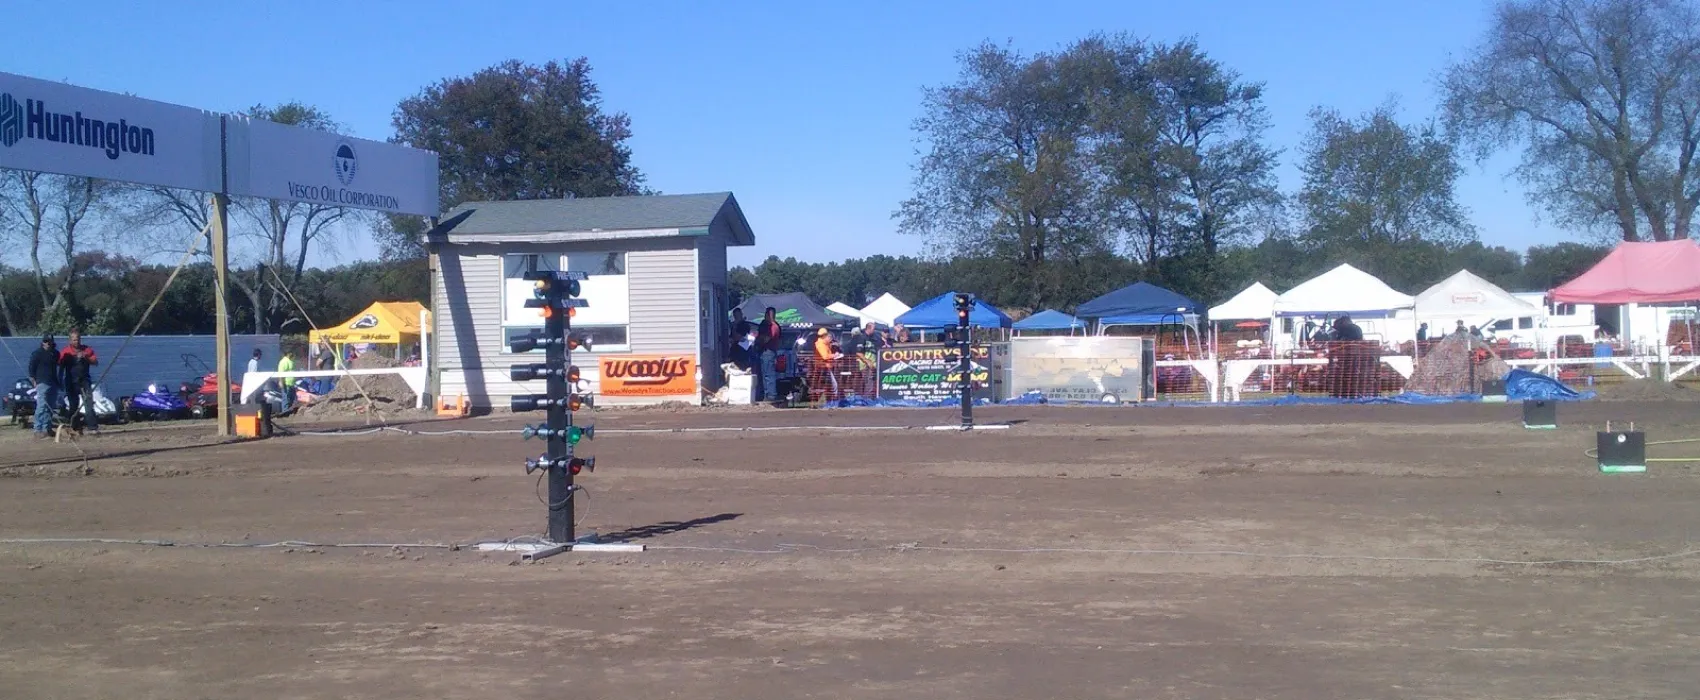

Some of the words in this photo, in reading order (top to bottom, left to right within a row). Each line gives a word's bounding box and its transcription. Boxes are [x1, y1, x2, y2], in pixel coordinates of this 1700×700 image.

[26, 98, 155, 160] Huntington
[288, 181, 319, 200] VESCO
[320, 185, 338, 202] OIL
[340, 188, 399, 209] CORPORATION
[882, 374, 917, 383] ARCTIC
[920, 373, 941, 382] CAT
